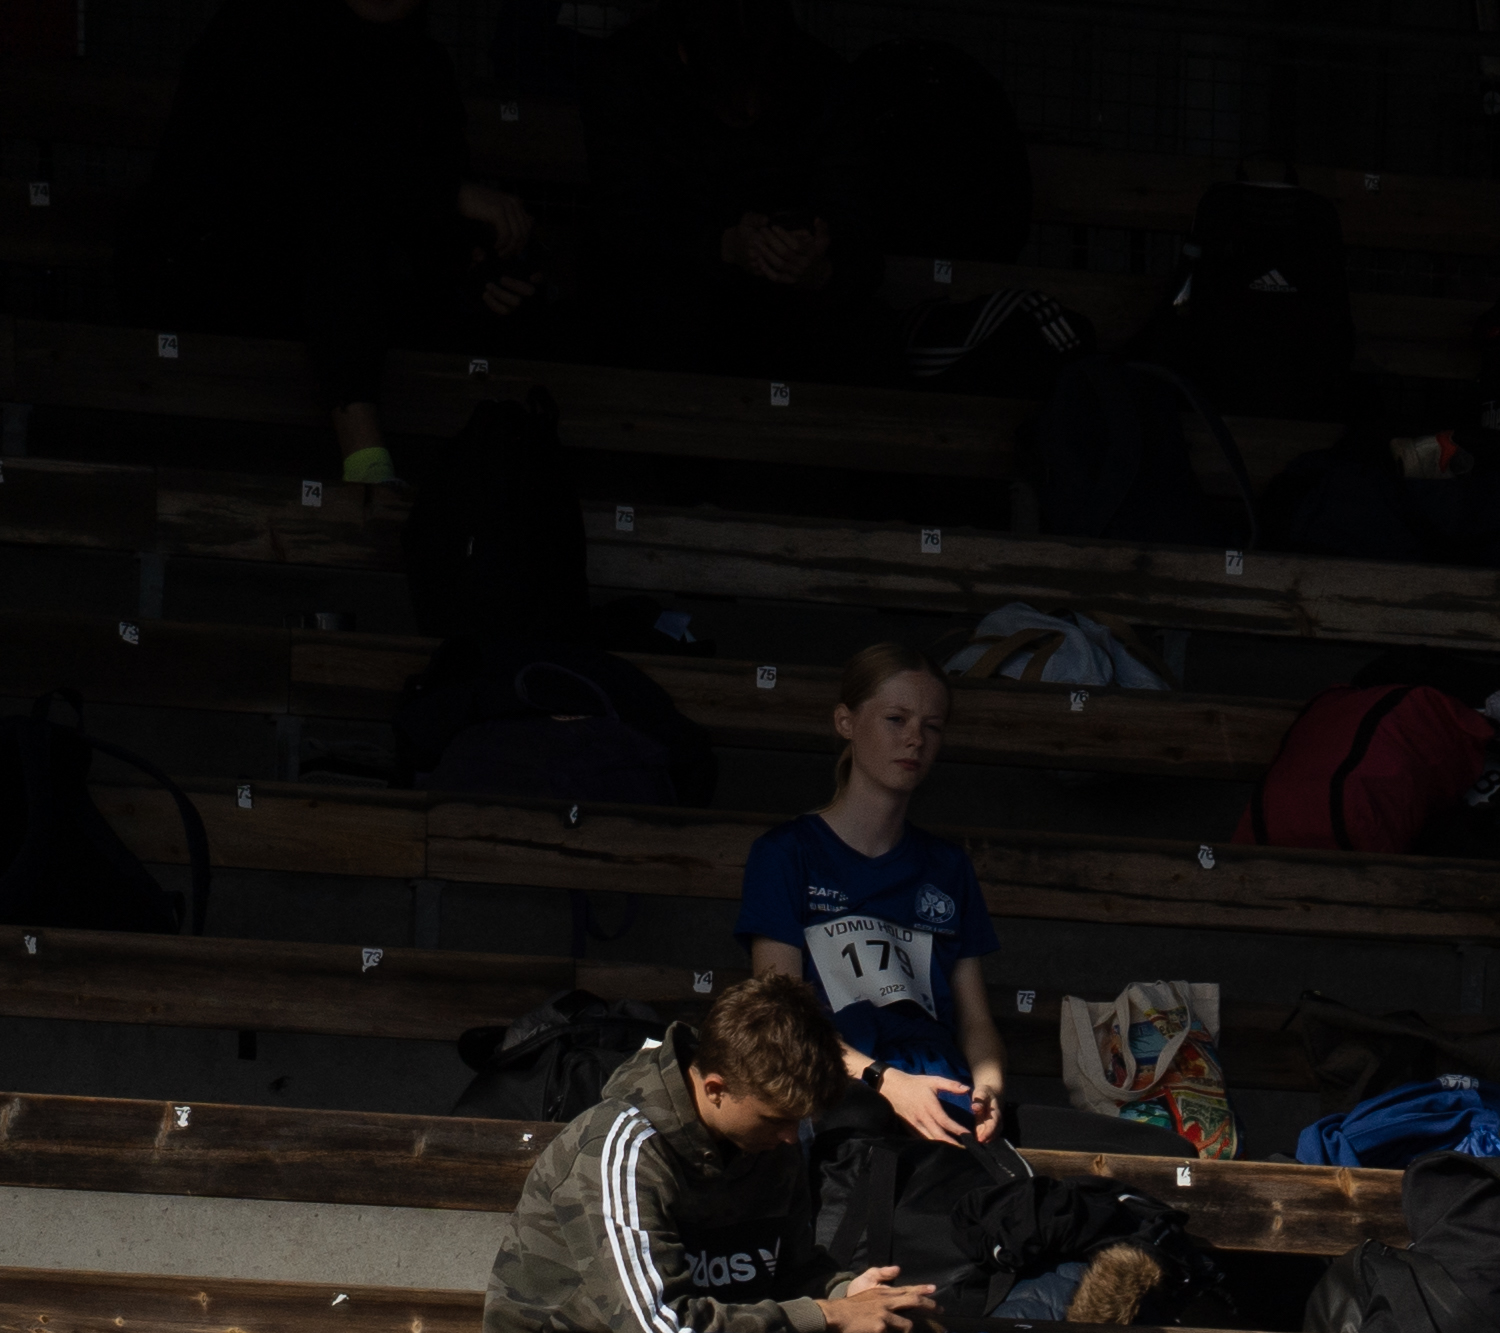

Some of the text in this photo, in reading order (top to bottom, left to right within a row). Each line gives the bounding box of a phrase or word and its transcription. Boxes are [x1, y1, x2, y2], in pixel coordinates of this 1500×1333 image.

[31, 183, 49, 199] 74
[934, 262, 953, 276] 77
[160, 335, 178, 351] 74
[771, 385, 790, 400] 76
[303, 485, 321, 499] 74
[615, 510, 634, 524] 75
[922, 532, 941, 546] 76
[1226, 554, 1244, 568] 77
[757, 668, 777, 681] 75
[823, 919, 913, 943] VDMU HOLD
[840, 939, 915, 980] 179
[879, 983, 907, 996] 2022
[1016, 991, 1036, 1006] 75
